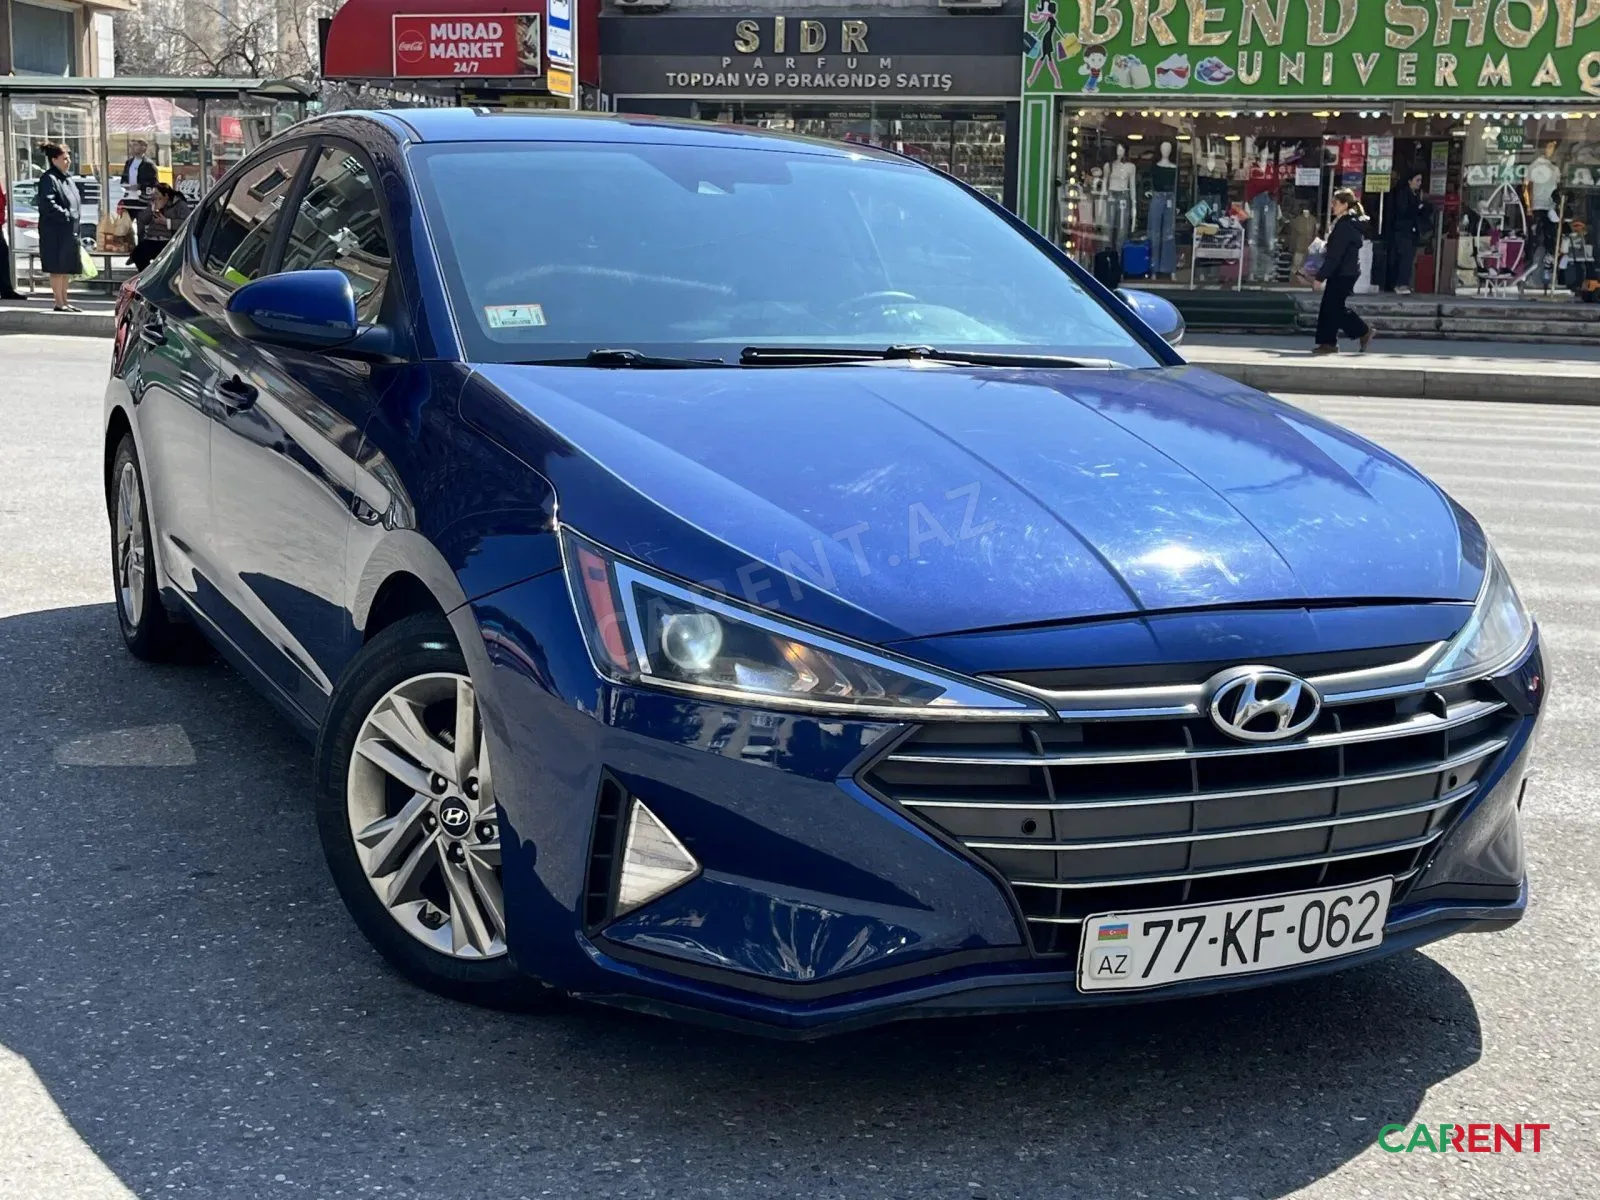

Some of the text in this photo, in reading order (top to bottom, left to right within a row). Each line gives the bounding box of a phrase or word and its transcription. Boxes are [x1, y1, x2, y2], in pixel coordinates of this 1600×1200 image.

[430, 22, 503, 41] MURAD
[1078, 0, 1600, 49] BREND SHOP
[430, 42, 504, 59] MARKET
[453, 61, 480, 73] 24/7
[722, 57, 892, 69] PARFUM
[666, 73, 953, 91] TOPDAN VƏ PƏRAKƏNDƏ SATIŞ
[1141, 890, 1381, 978] 77-KF-062
[1097, 954, 1128, 975] AZ
